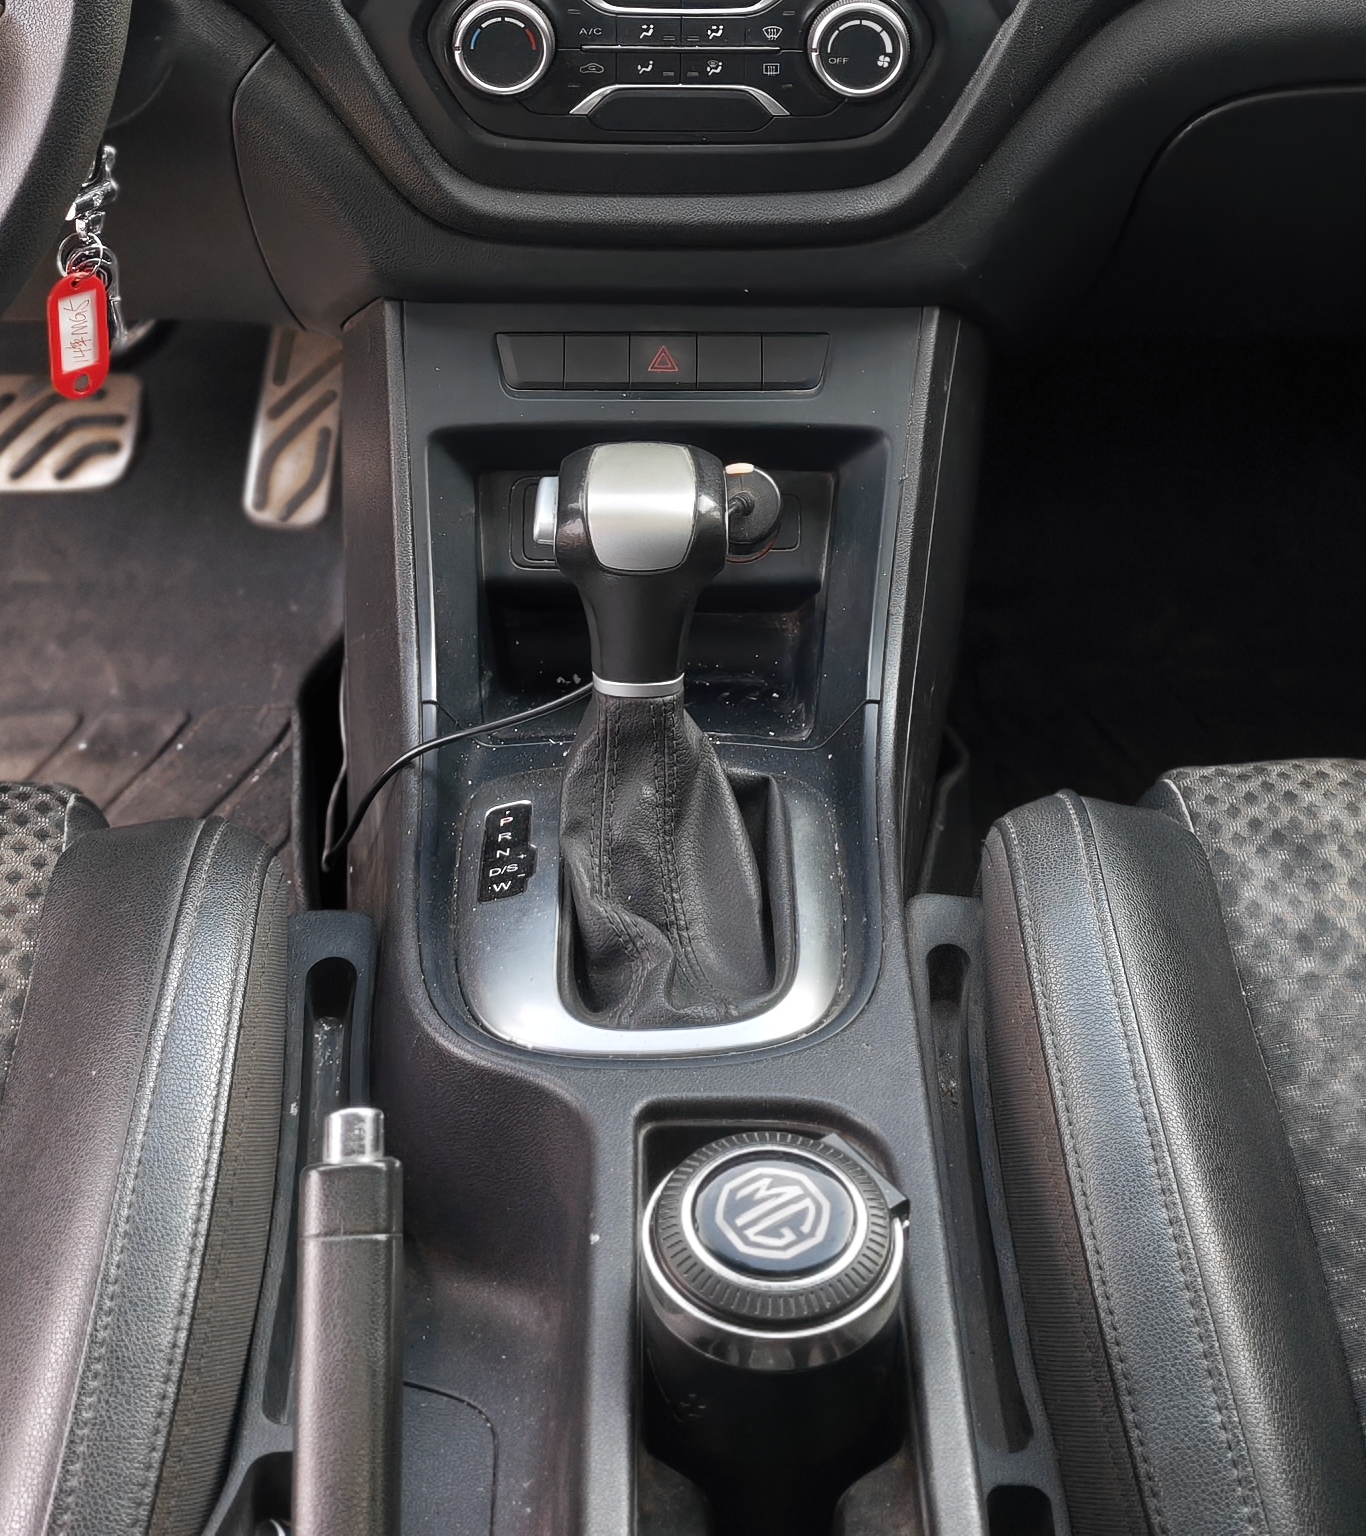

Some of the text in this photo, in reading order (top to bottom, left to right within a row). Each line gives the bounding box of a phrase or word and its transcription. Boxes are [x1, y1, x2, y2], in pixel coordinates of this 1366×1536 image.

[579, 27, 603, 36] A/C
[828, 57, 849, 65] OFF
[500, 816, 514, 827] P
[498, 831, 512, 842] R
[496, 847, 511, 859] N
[489, 863, 519, 878] D/S
[493, 880, 512, 892] W
[735, 1177, 817, 1248] MG
